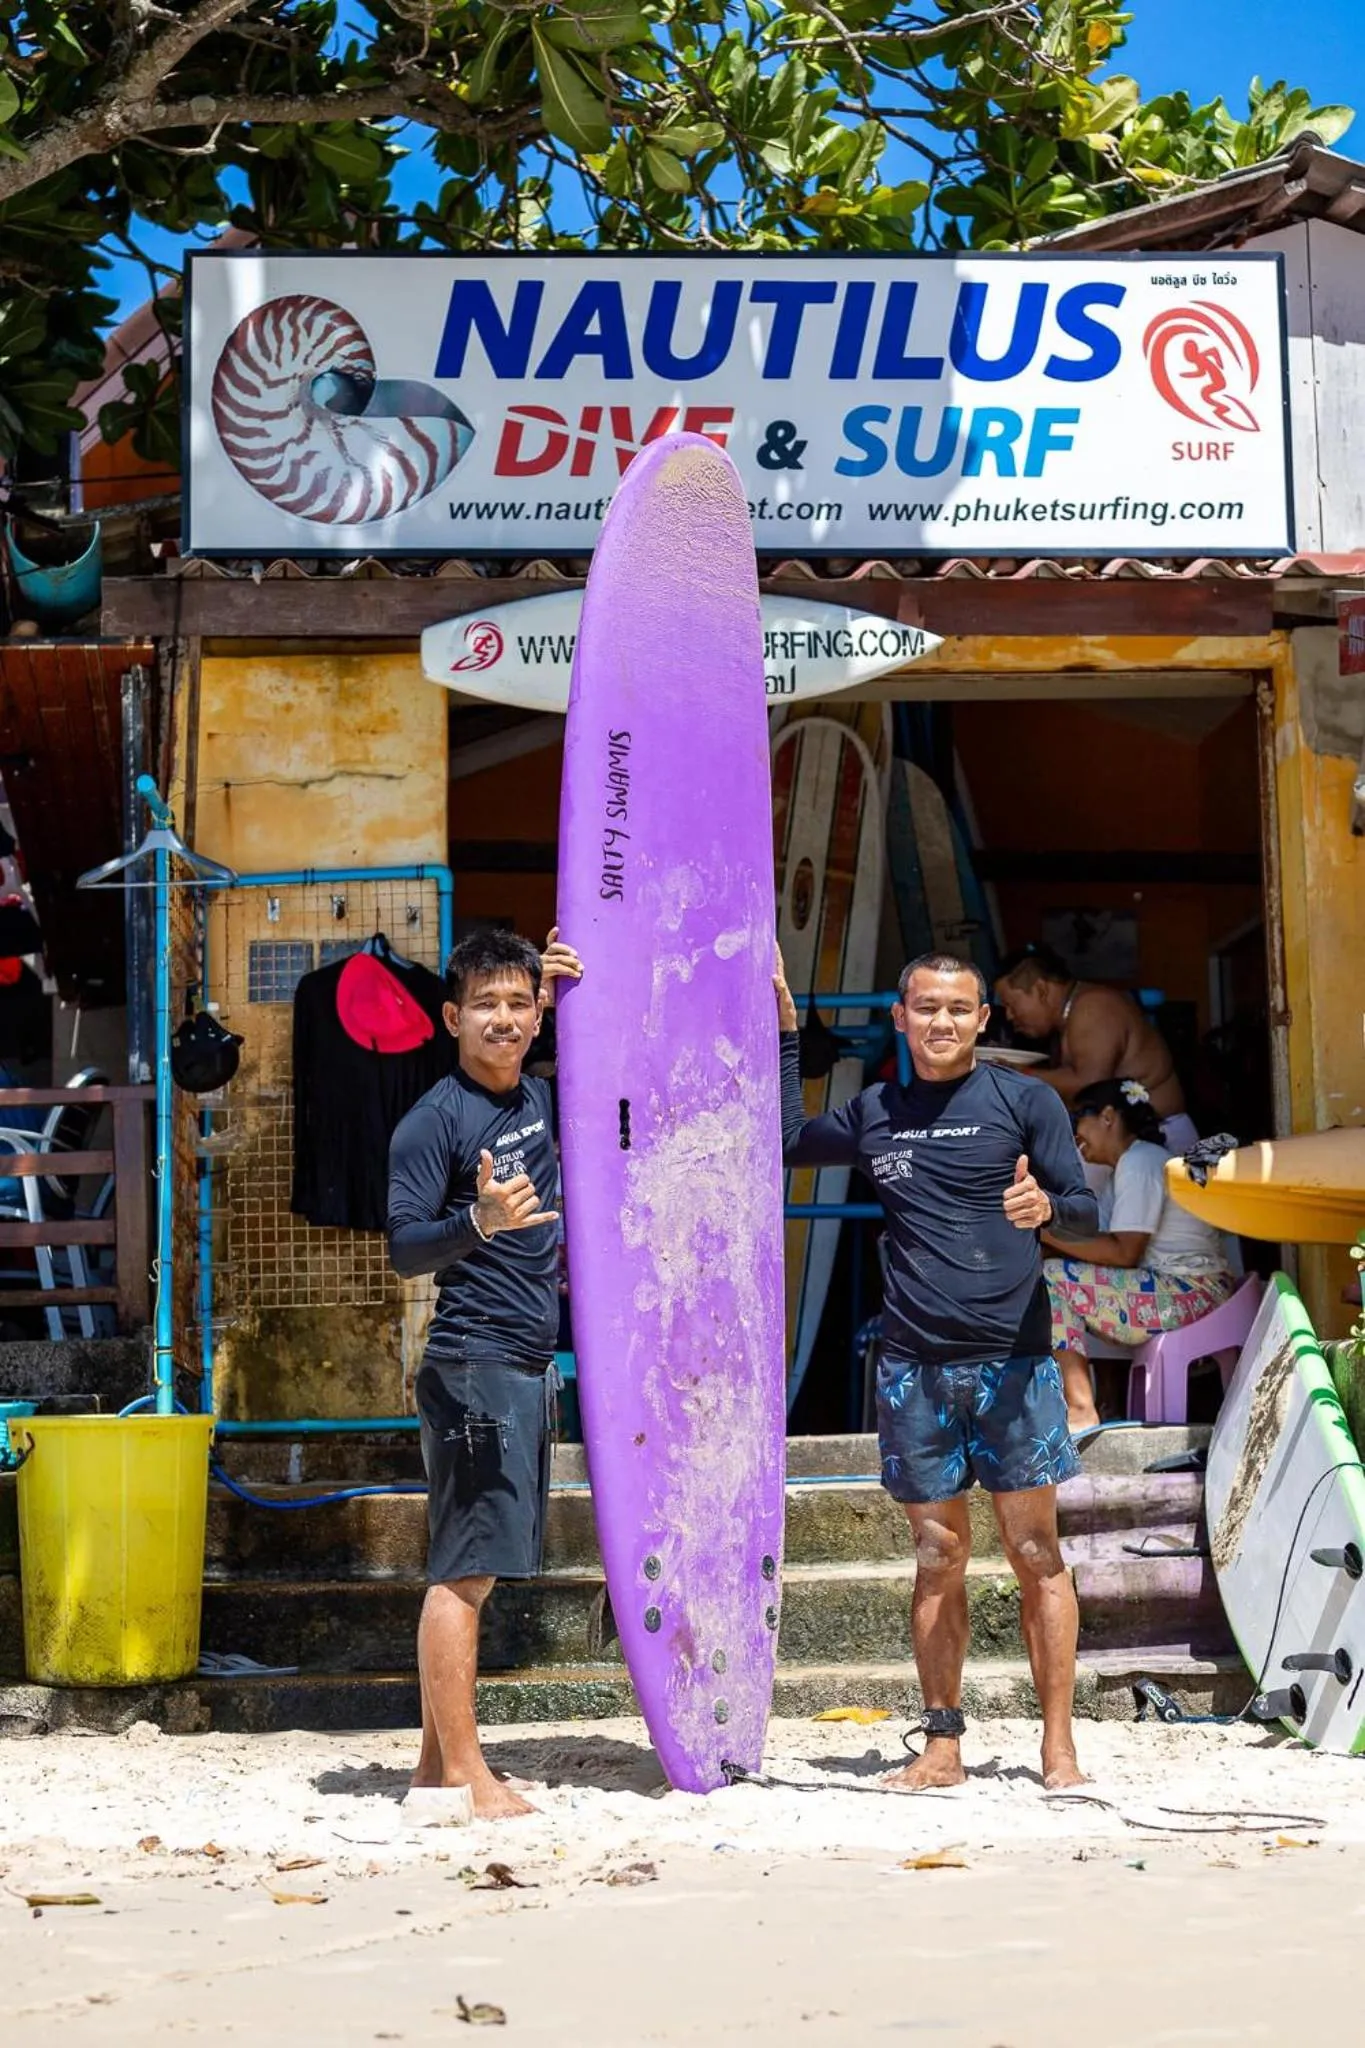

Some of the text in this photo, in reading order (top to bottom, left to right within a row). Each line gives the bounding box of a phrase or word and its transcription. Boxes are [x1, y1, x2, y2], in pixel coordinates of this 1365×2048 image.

[433, 279, 1127, 381] NAUTILUS
[756, 420, 808, 470] &
[834, 404, 1081, 478] SURF
[1171, 441, 1235, 461] SURF
[867, 496, 1245, 528] www.phuketsurfing.com
[600, 728, 632, 902] SALTY SWAMIS
[496, 1131, 521, 1147] AQUA
[892, 1125, 981, 1140] AQUA SPORT
[493, 1149, 525, 1166] UTILUS
[871, 1149, 913, 1168] NAUTILUS
[873, 1161, 893, 1177] SURF
